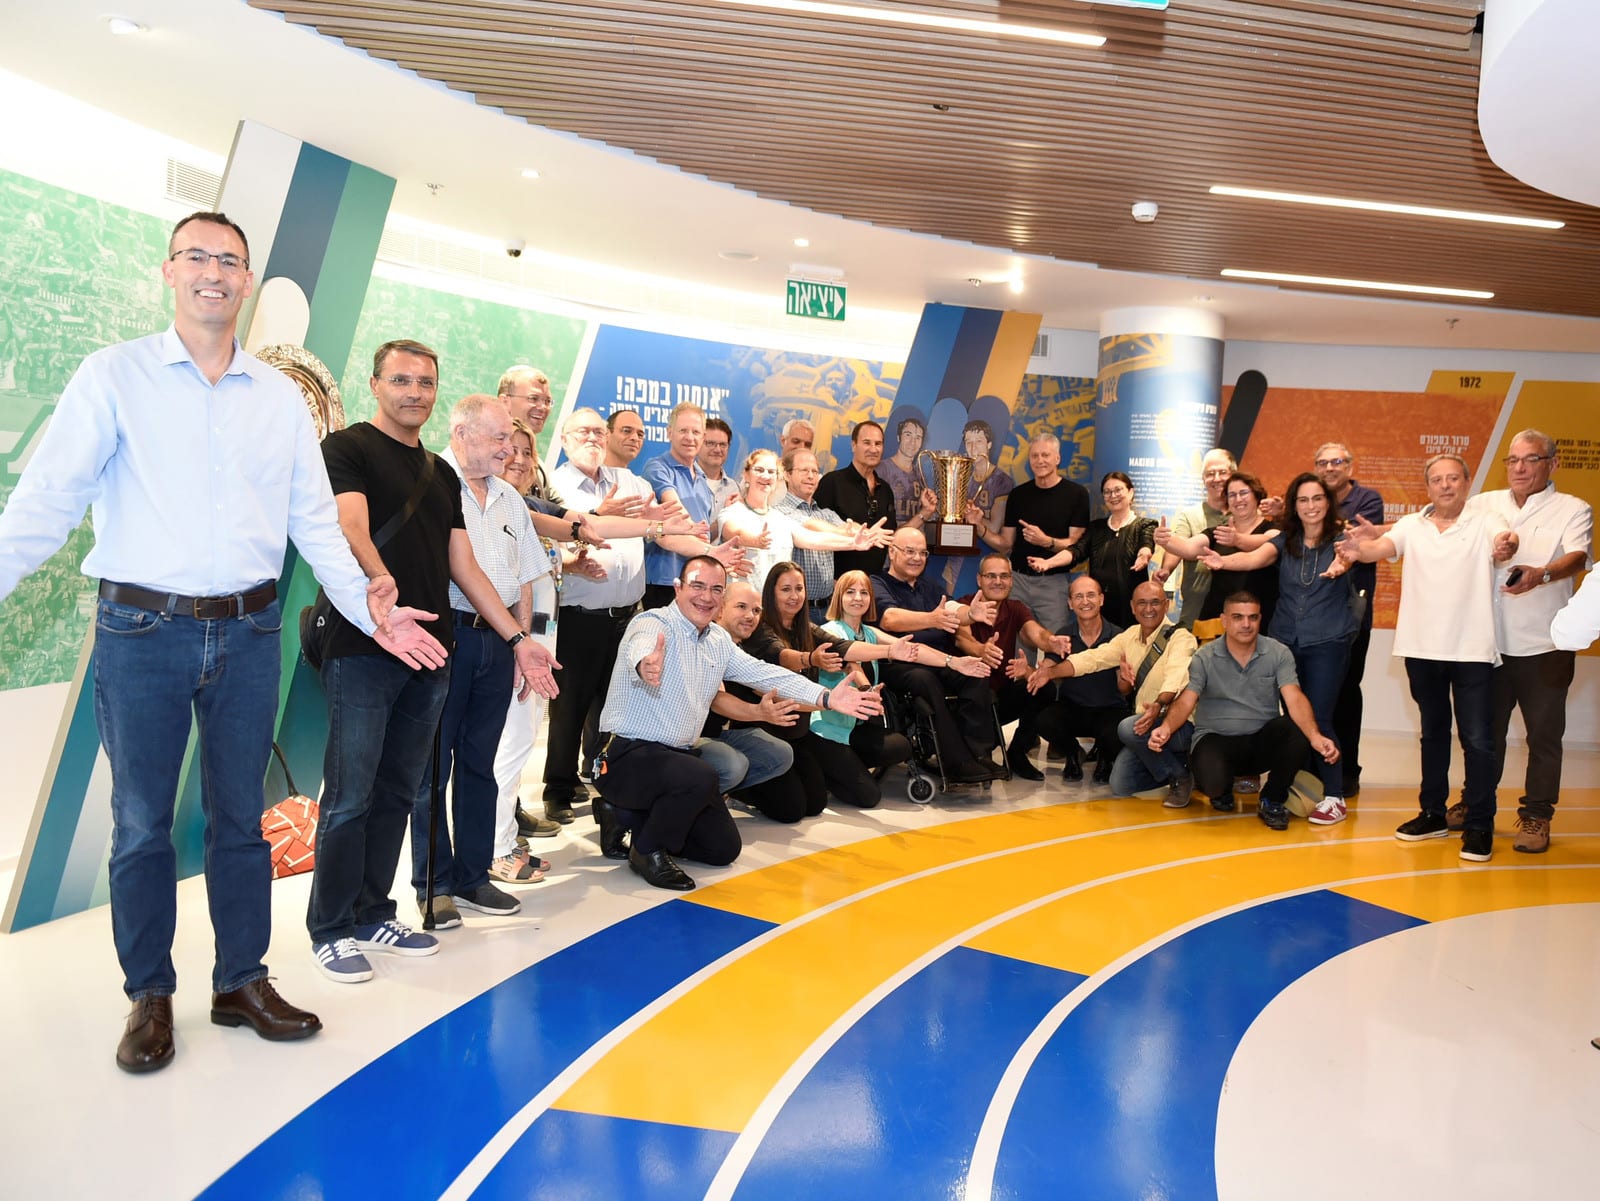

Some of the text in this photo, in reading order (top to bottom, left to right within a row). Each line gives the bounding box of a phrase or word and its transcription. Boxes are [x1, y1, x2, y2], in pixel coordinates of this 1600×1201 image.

[788, 282, 834, 317] יציאה
[616, 375, 671, 406] במפה!
[1459, 376, 1482, 388] 1972
[978, 490, 989, 507] 9
